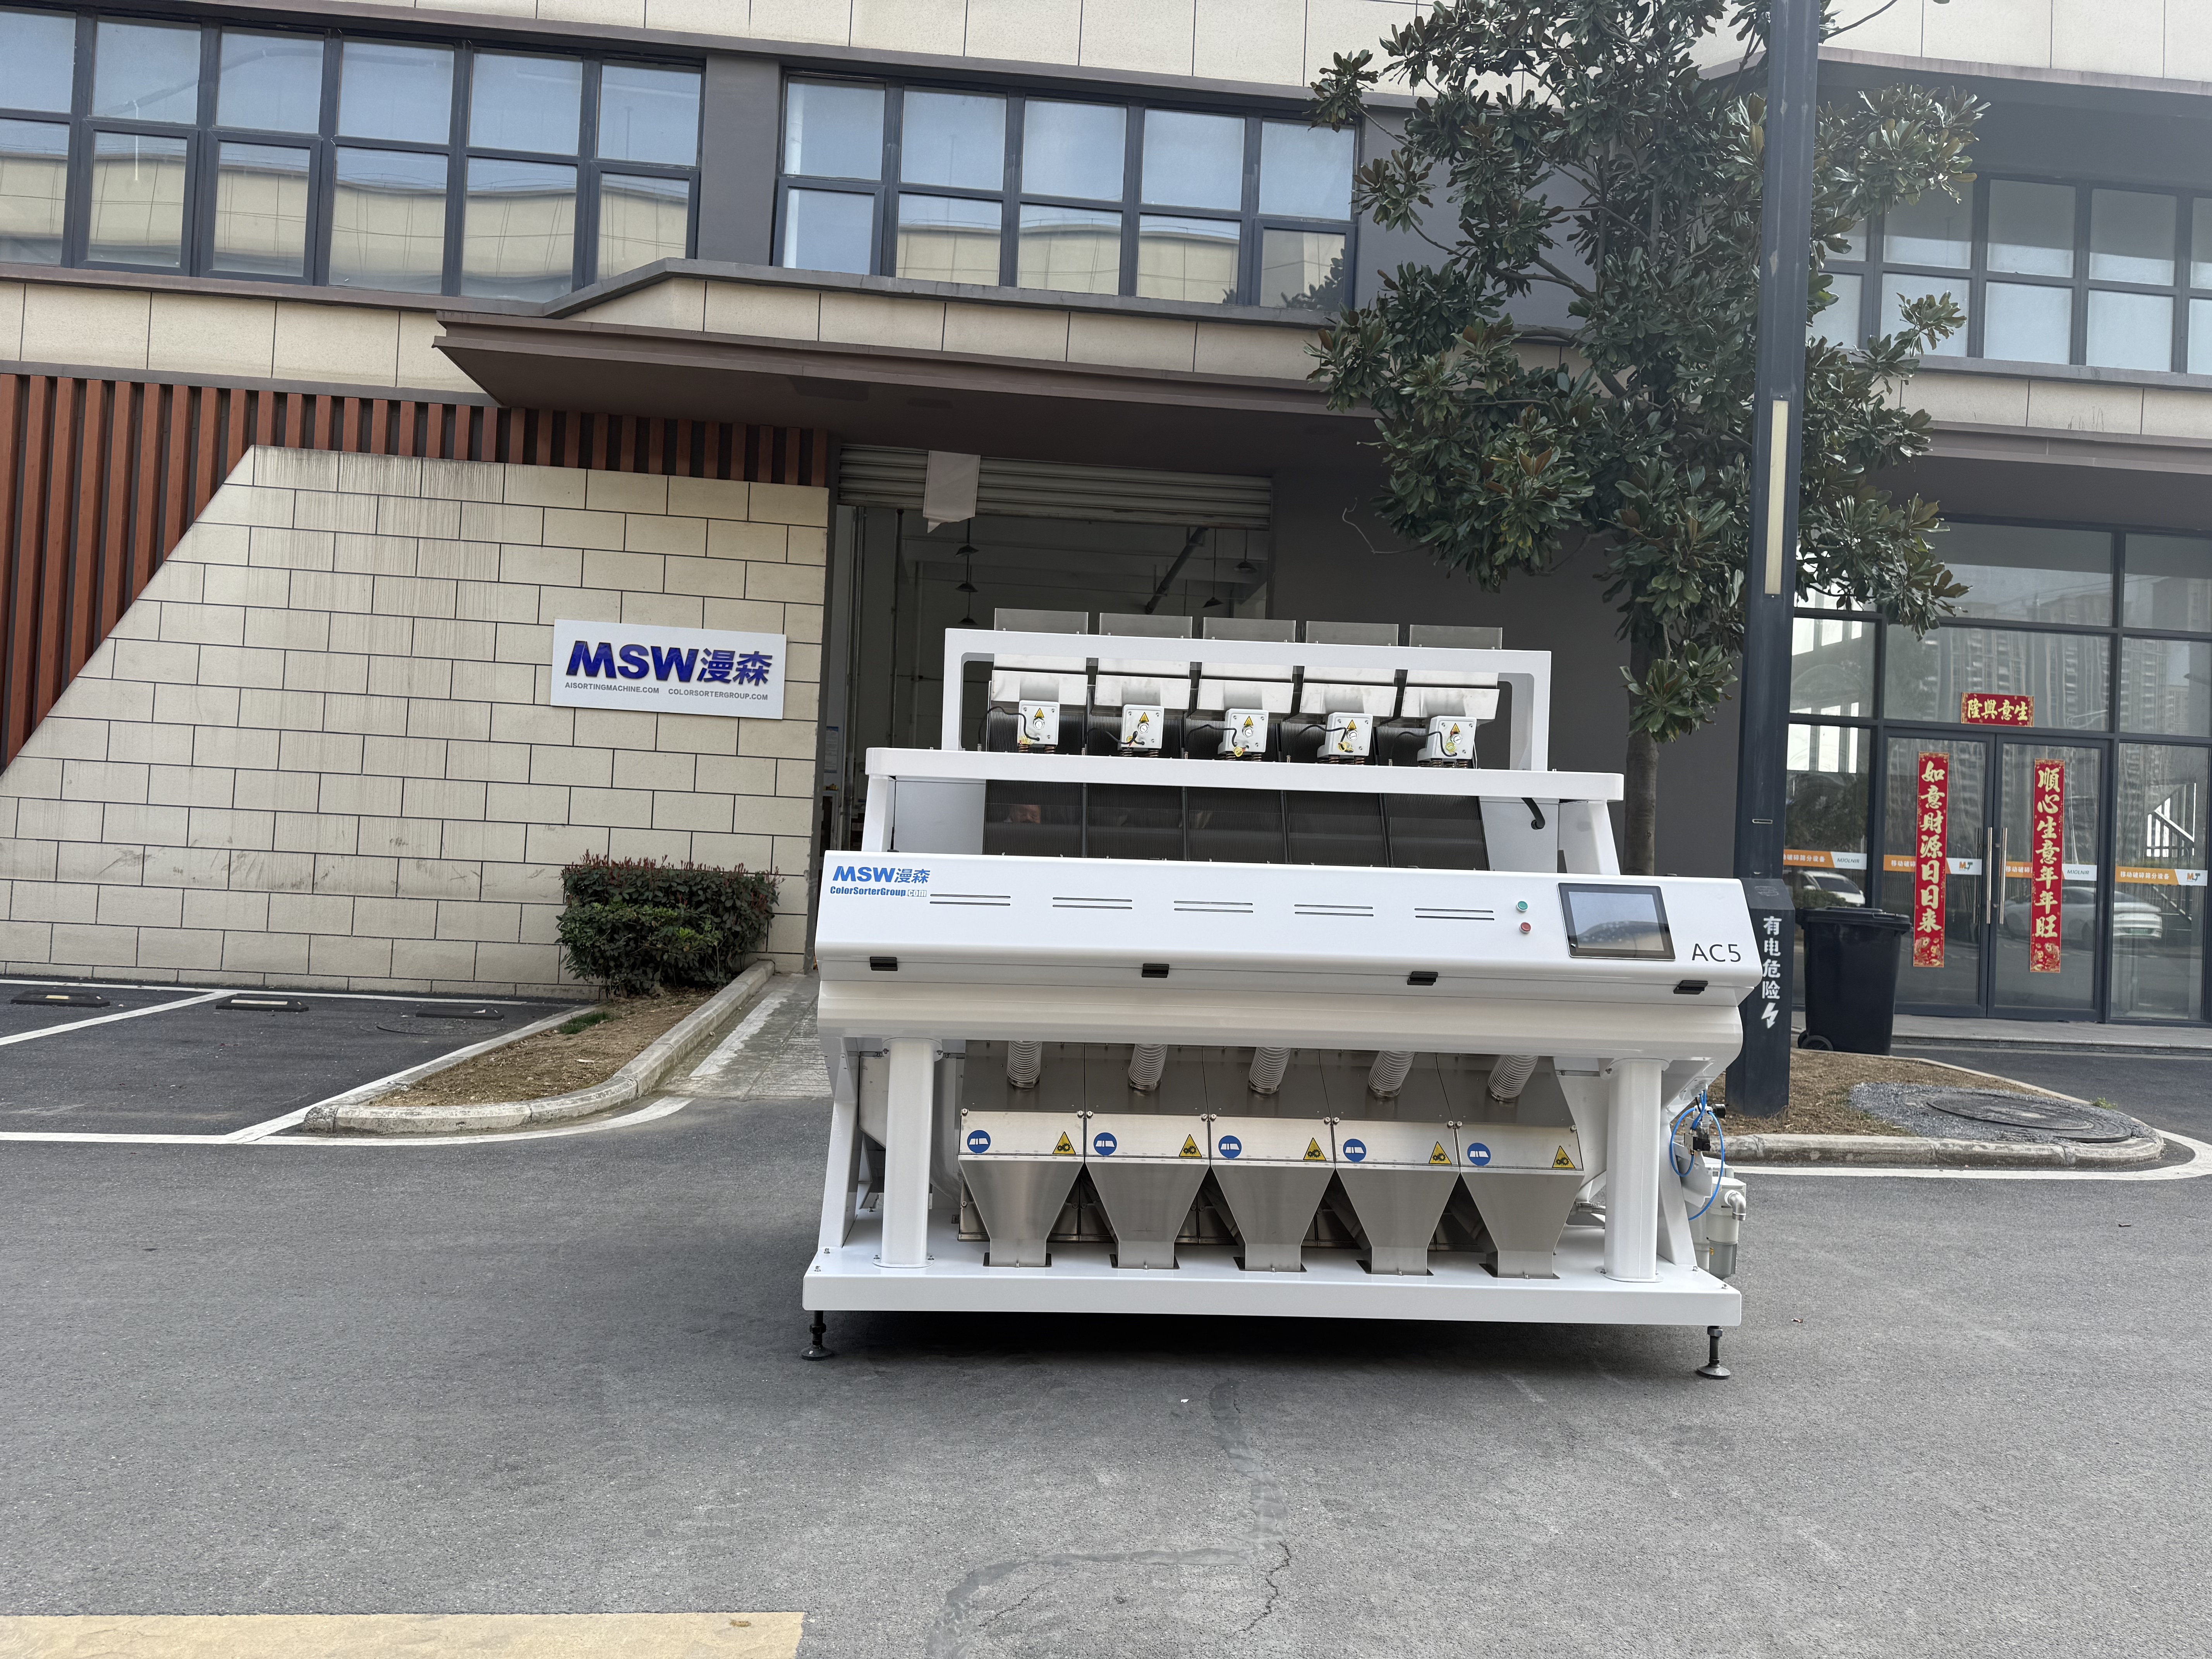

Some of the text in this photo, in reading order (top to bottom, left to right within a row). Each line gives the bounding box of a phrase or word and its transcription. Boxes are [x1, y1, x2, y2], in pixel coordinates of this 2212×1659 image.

[566, 640, 773, 686] MSW漫森
[565, 682, 768, 701] AISORTINGMACHINE.COM COLORSORTERGROUP.COM
[2035, 767, 2060, 938] 順心生意年年旺
[833, 866, 930, 884] MSW漫森
[2120, 871, 2169, 880] 移动破碎筛分设备
[830, 886, 927, 897] ColorSorterGroup.com
[1692, 943, 1741, 962] AC5
[1762, 915, 1782, 999] 有电危险
